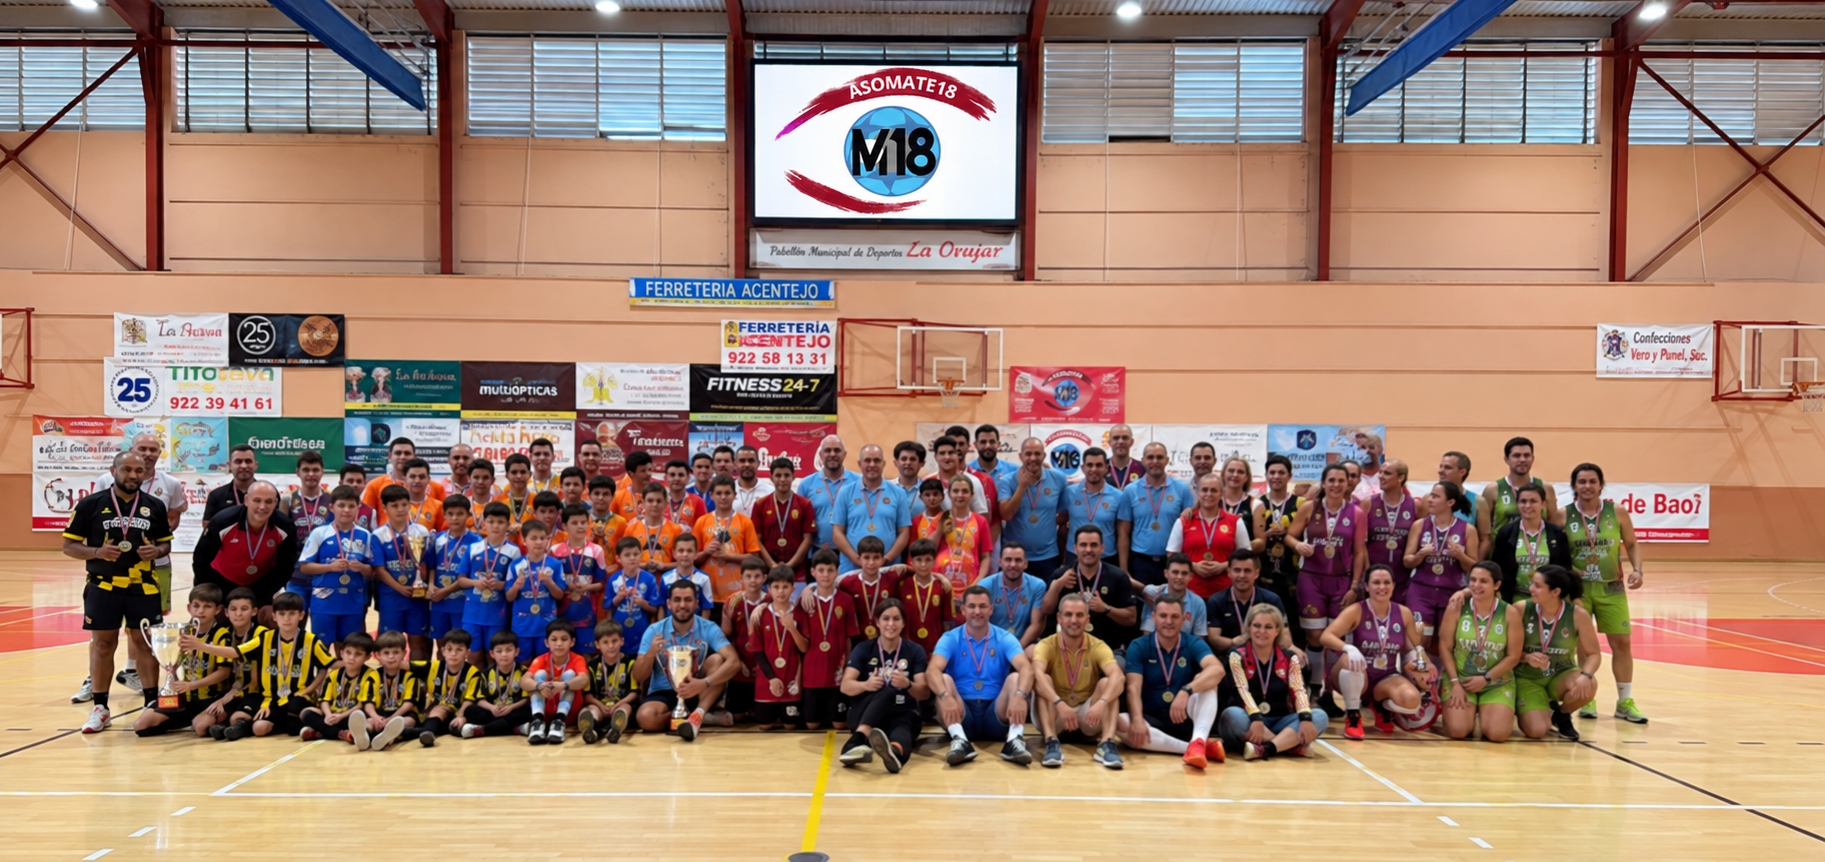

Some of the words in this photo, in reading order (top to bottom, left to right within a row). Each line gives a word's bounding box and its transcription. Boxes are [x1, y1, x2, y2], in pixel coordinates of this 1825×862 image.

[850, 75, 958, 100] ASOMATE18
[808, 246, 852, 260] Municipal
[853, 247, 864, 257] de
[866, 247, 903, 261] Deportes
[906, 240, 932, 258] La
[646, 281, 737, 298] FERRETERIA
[742, 283, 820, 299] ACENTEJO
[243, 321, 271, 344] 25
[738, 321, 830, 334] FERRETERÍA
[1633, 332, 1692, 345] Confecciones
[729, 351, 757, 365] 922
[762, 352, 782, 365] 58
[788, 353, 805, 365] 13
[810, 353, 828, 365] 31
[1631, 348, 1651, 361] Vero
[1651, 351, 1658, 364] y
[116, 377, 152, 403] 25
[170, 397, 199, 410] 922
[205, 397, 225, 410] 39
[229, 397, 247, 410] 41
[254, 397, 273, 410] 61
